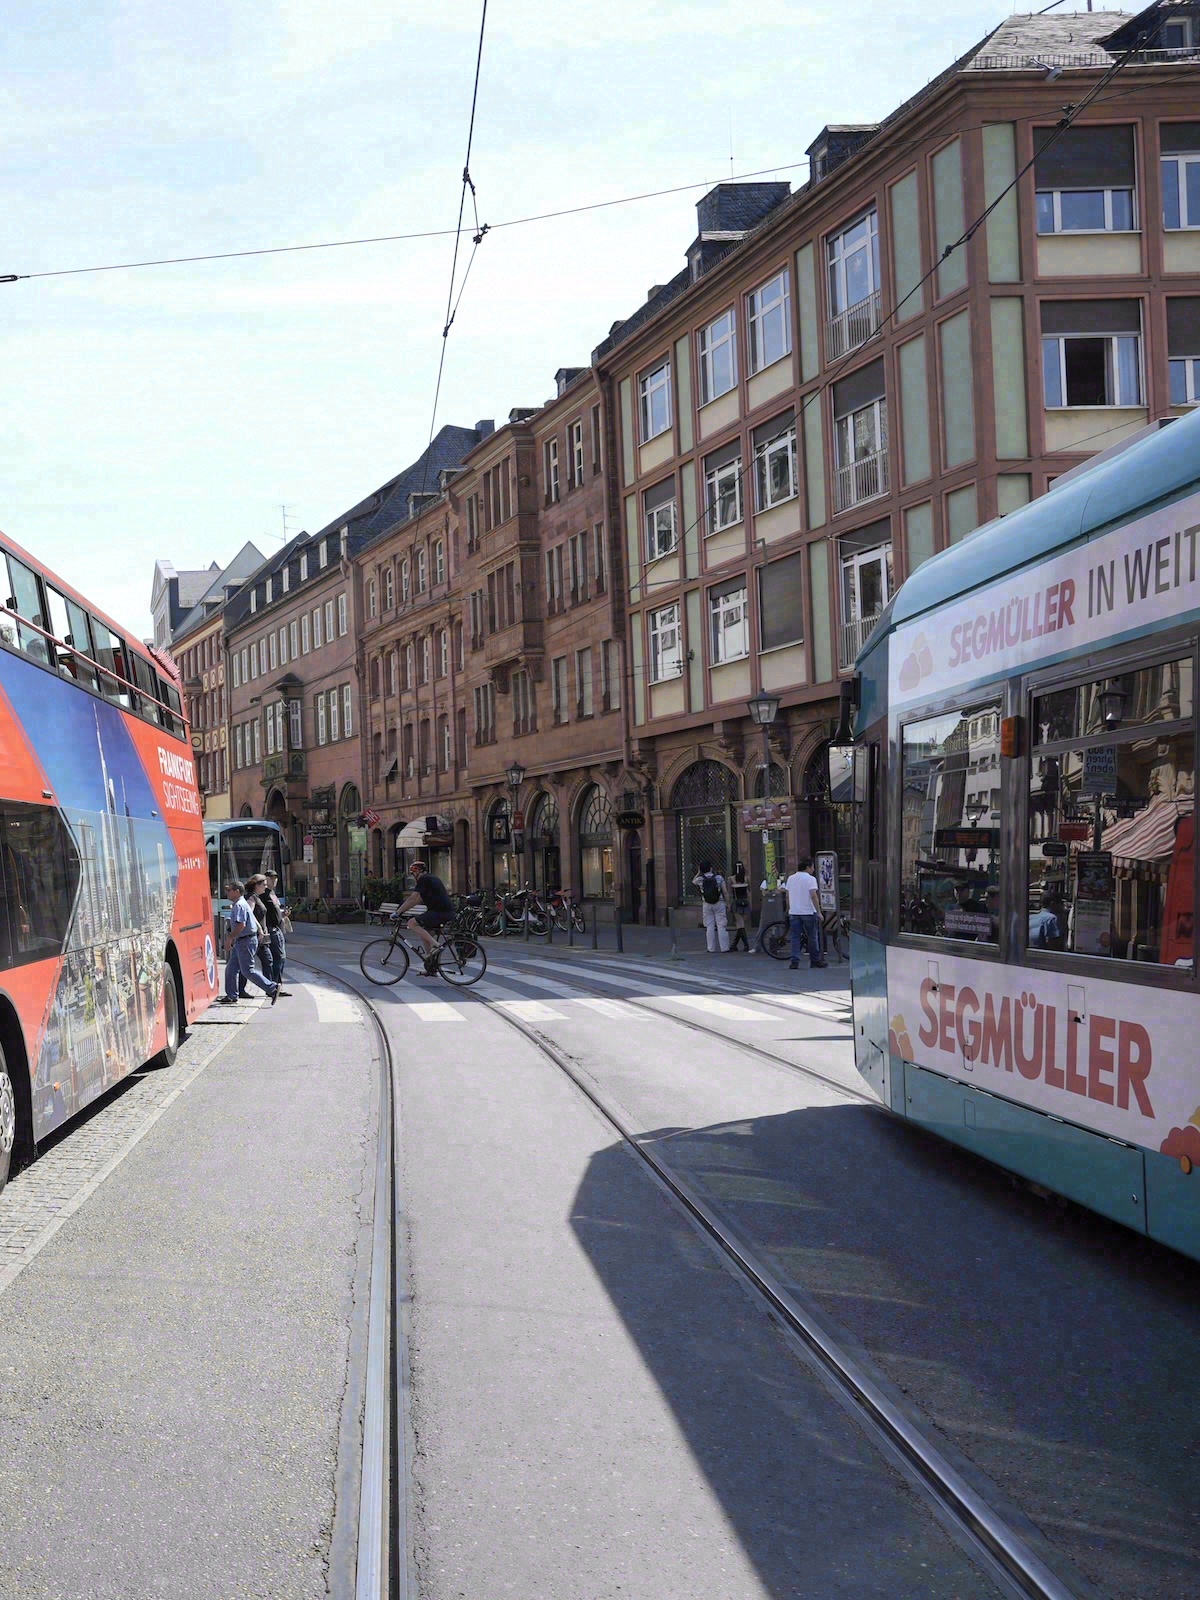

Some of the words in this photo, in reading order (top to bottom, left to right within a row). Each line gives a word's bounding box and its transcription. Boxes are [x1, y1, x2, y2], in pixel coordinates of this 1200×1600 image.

[949, 577, 1076, 668] SEGMÜLLER
[1088, 560, 1115, 618] IN
[157, 746, 195, 785] FRANKFURT
[162, 780, 199, 815] SIGHTSEEING
[918, 977, 1156, 1119] SEGMÜLLER
